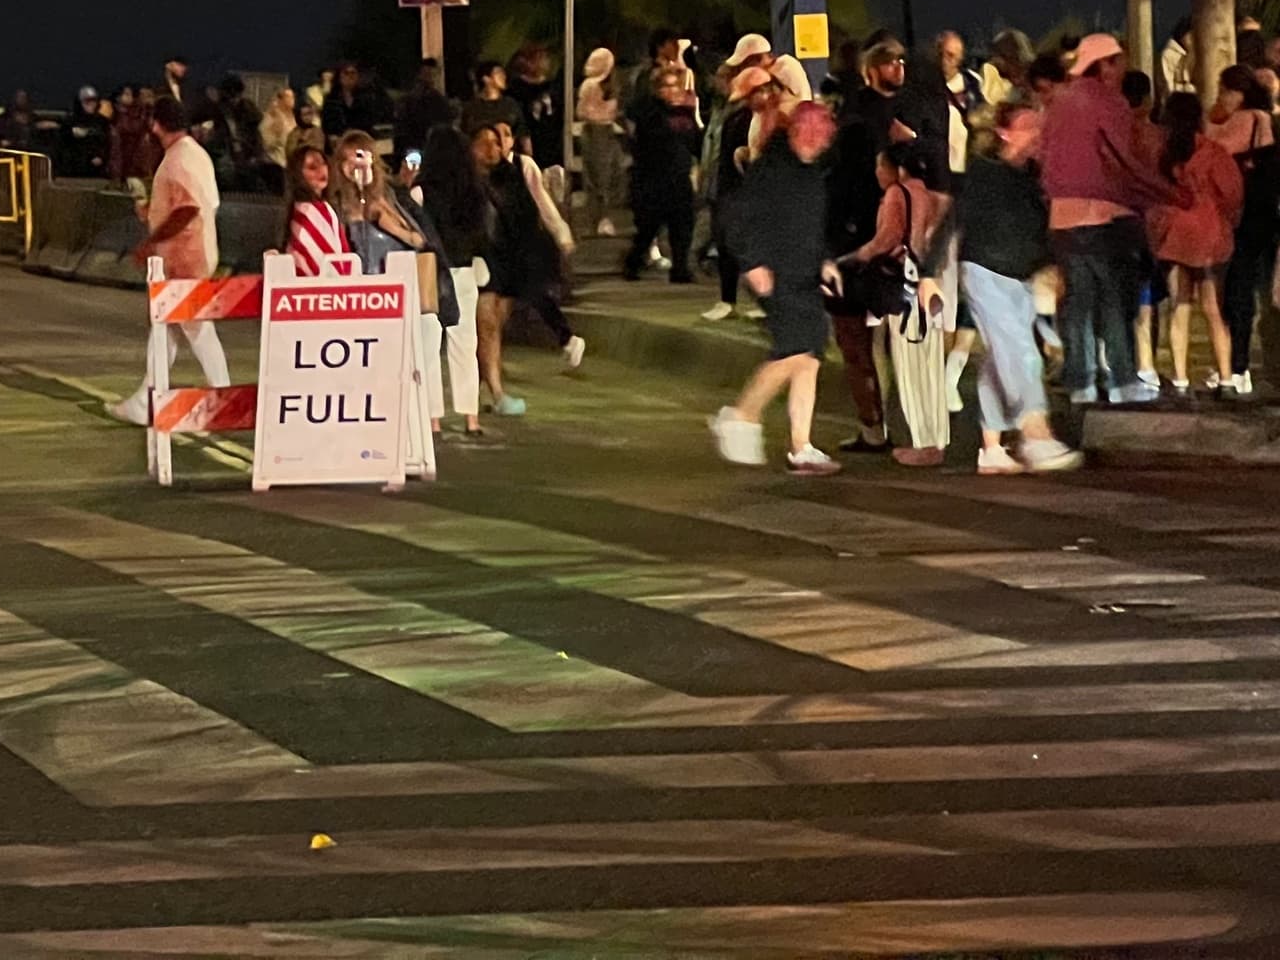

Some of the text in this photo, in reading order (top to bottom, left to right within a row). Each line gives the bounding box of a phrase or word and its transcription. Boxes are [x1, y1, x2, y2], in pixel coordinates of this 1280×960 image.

[276, 292, 399, 313] ATTENTION
[294, 338, 379, 369] LOT
[279, 394, 387, 424] FULL
